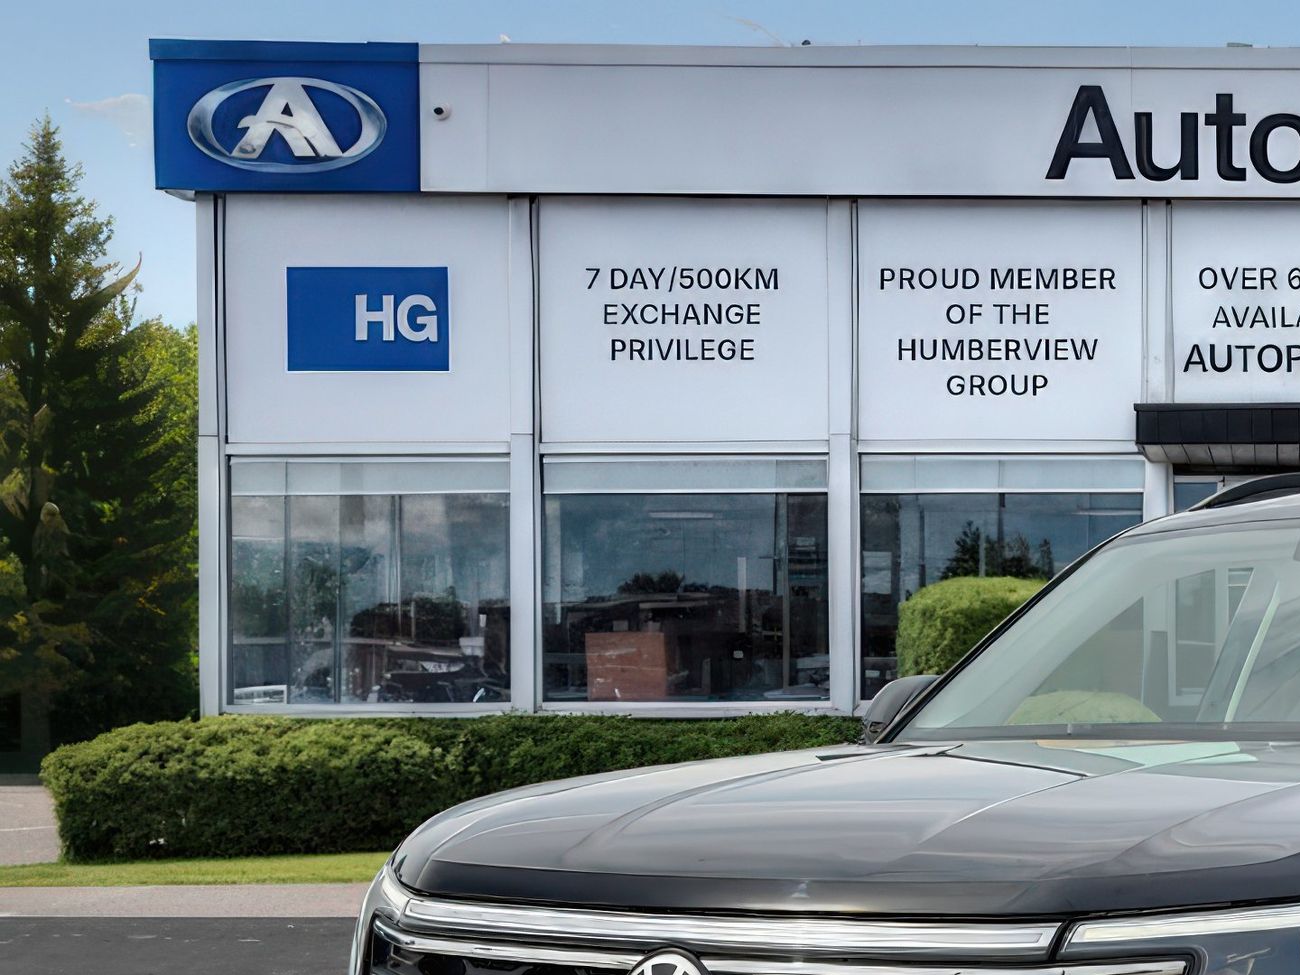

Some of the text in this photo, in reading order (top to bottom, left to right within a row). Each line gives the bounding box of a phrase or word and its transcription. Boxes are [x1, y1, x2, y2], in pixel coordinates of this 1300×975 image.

[586, 266, 779, 293] 7 DAY/500KM
[879, 267, 1117, 291] PROUD MEMBER
[1198, 266, 1279, 291] OVER
[355, 294, 439, 343] HG
[603, 303, 761, 326] EXCHANGE
[945, 303, 1049, 325] OF THE
[610, 338, 755, 361] PRIVILEGE
[898, 338, 1099, 361] HUMBERVIEW
[946, 374, 1049, 397] GROUP
